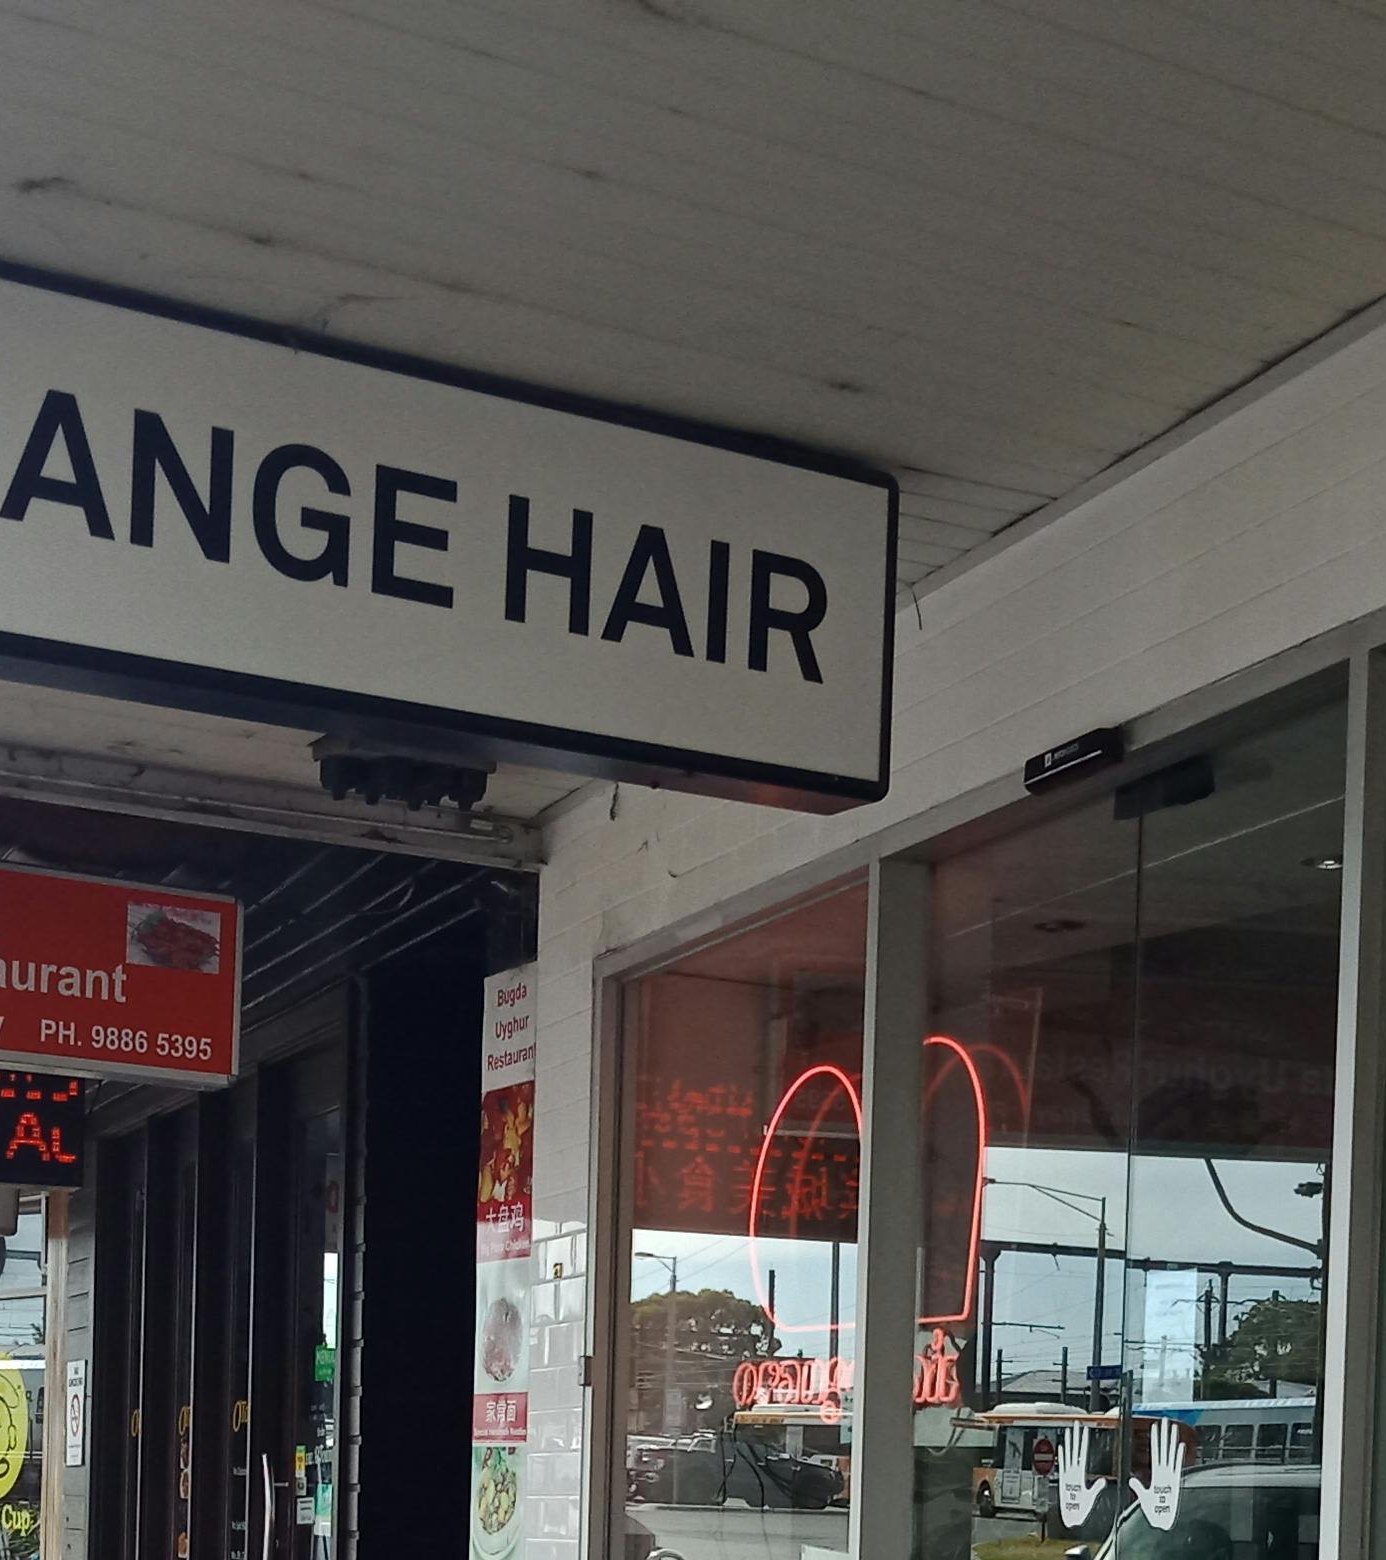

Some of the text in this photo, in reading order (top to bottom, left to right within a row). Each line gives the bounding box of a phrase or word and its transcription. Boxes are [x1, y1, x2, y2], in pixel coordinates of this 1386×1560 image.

[503, 492, 831, 686] HAIR
[496, 982, 527, 1007] Bugda
[39, 1018, 82, 1047] PH.
[91, 1024, 149, 1054] 9886
[156, 1032, 213, 1061] 5395
[495, 1015, 530, 1041] Uyghur
[487, 1042, 537, 1071] Restaurant
[1065, 1483, 1081, 1492] touch
[1154, 1484, 1172, 1494] touch
[1065, 1502, 1080, 1511] open
[1154, 1505, 1170, 1516] open
[2, 1504, 32, 1537] Cup
